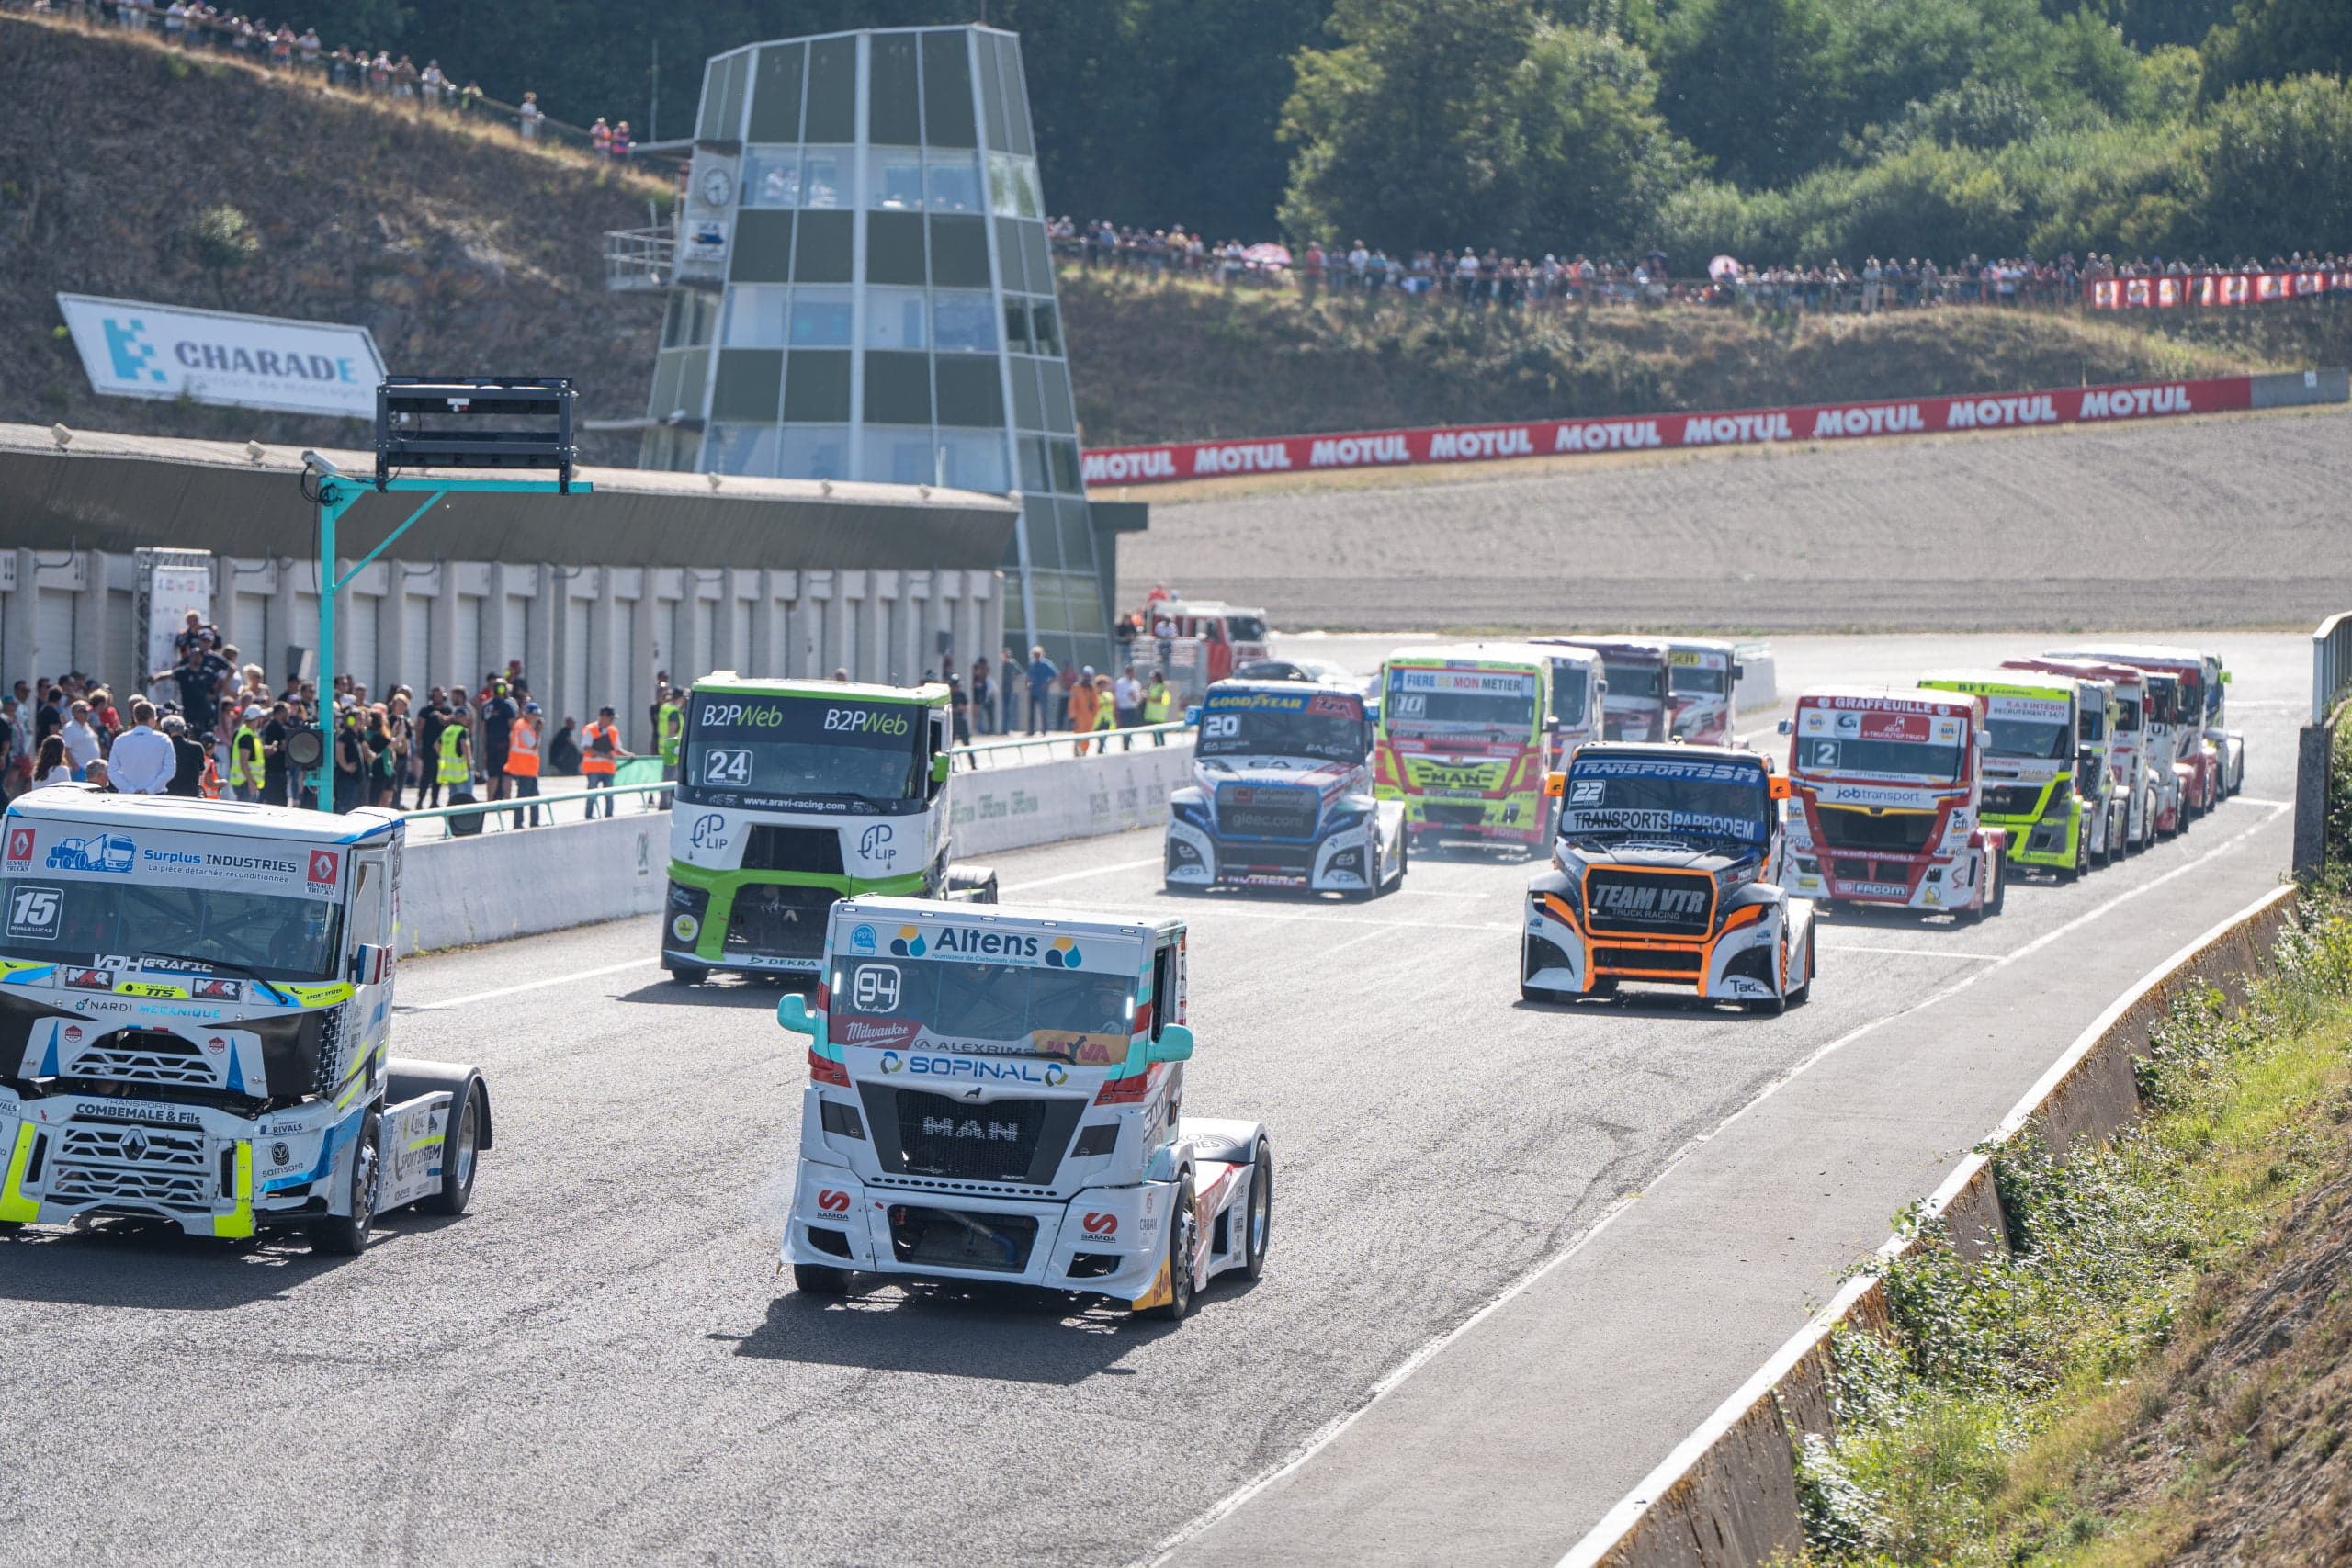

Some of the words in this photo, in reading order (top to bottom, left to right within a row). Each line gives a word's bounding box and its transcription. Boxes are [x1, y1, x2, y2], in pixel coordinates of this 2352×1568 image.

[174, 341, 358, 384] CHARADE
[1083, 451, 1175, 480] MOTUL
[1195, 443, 1291, 473] MOTUL
[1310, 435, 1409, 466] MOTUL
[1430, 428, 1532, 458] MOTUL
[1555, 421, 1661, 451] MOTUL
[1684, 412, 1792, 444] MOTUL
[1815, 404, 1923, 434] MOTUL
[1947, 395, 2057, 428] MOTUL
[2080, 386, 2191, 419] MOTUL
[1453, 676, 1479, 688] MON
[1208, 694, 1302, 710] GOODYEAR
[1396, 695, 1423, 711] 10
[1835, 697, 1932, 713] GRAFFEUILLE
[701, 705, 783, 727] B2PWeb
[824, 709, 909, 736] B2PWeb
[1206, 716, 1238, 736] 20
[1816, 744, 1836, 765] 2
[708, 752, 747, 780] 24
[1432, 773, 1480, 784] MAN
[1571, 782, 1603, 802] 22
[1836, 787, 1919, 803] jobtransport
[744, 796, 846, 811] www.aravi-racing.com
[1574, 811, 1669, 829] TRANSPORTS
[707, 837, 729, 850] LIP
[143, 850, 201, 863] Surplus
[206, 854, 297, 873] INDUSTRIES
[875, 848, 897, 861] LIP
[161, 864, 183, 874] pièce
[1594, 884, 1658, 910] TEAM
[1659, 889, 1707, 914] VTR
[14, 892, 59, 926] 15
[1612, 908, 1643, 918] TRUCK
[1645, 910, 1680, 920] RACING
[934, 927, 1038, 956] Altens
[768, 959, 817, 968] DEKRA
[66, 969, 110, 986] MKR
[146, 989, 175, 998] TTS
[195, 979, 236, 996] MKR
[858, 972, 896, 1004] 94
[90, 998, 132, 1012] NARDI
[846, 1021, 909, 1041] Milwaukee
[910, 1056, 1041, 1082] SOPINAL
[105, 1098, 175, 1110] TRANSPORTS
[76, 1103, 163, 1121] COMBEMALE
[166, 1111, 175, 1122] &
[179, 1112, 201, 1124] Fils
[273, 1123, 303, 1134] RIVALS
[922, 1116, 1018, 1141] MAN
